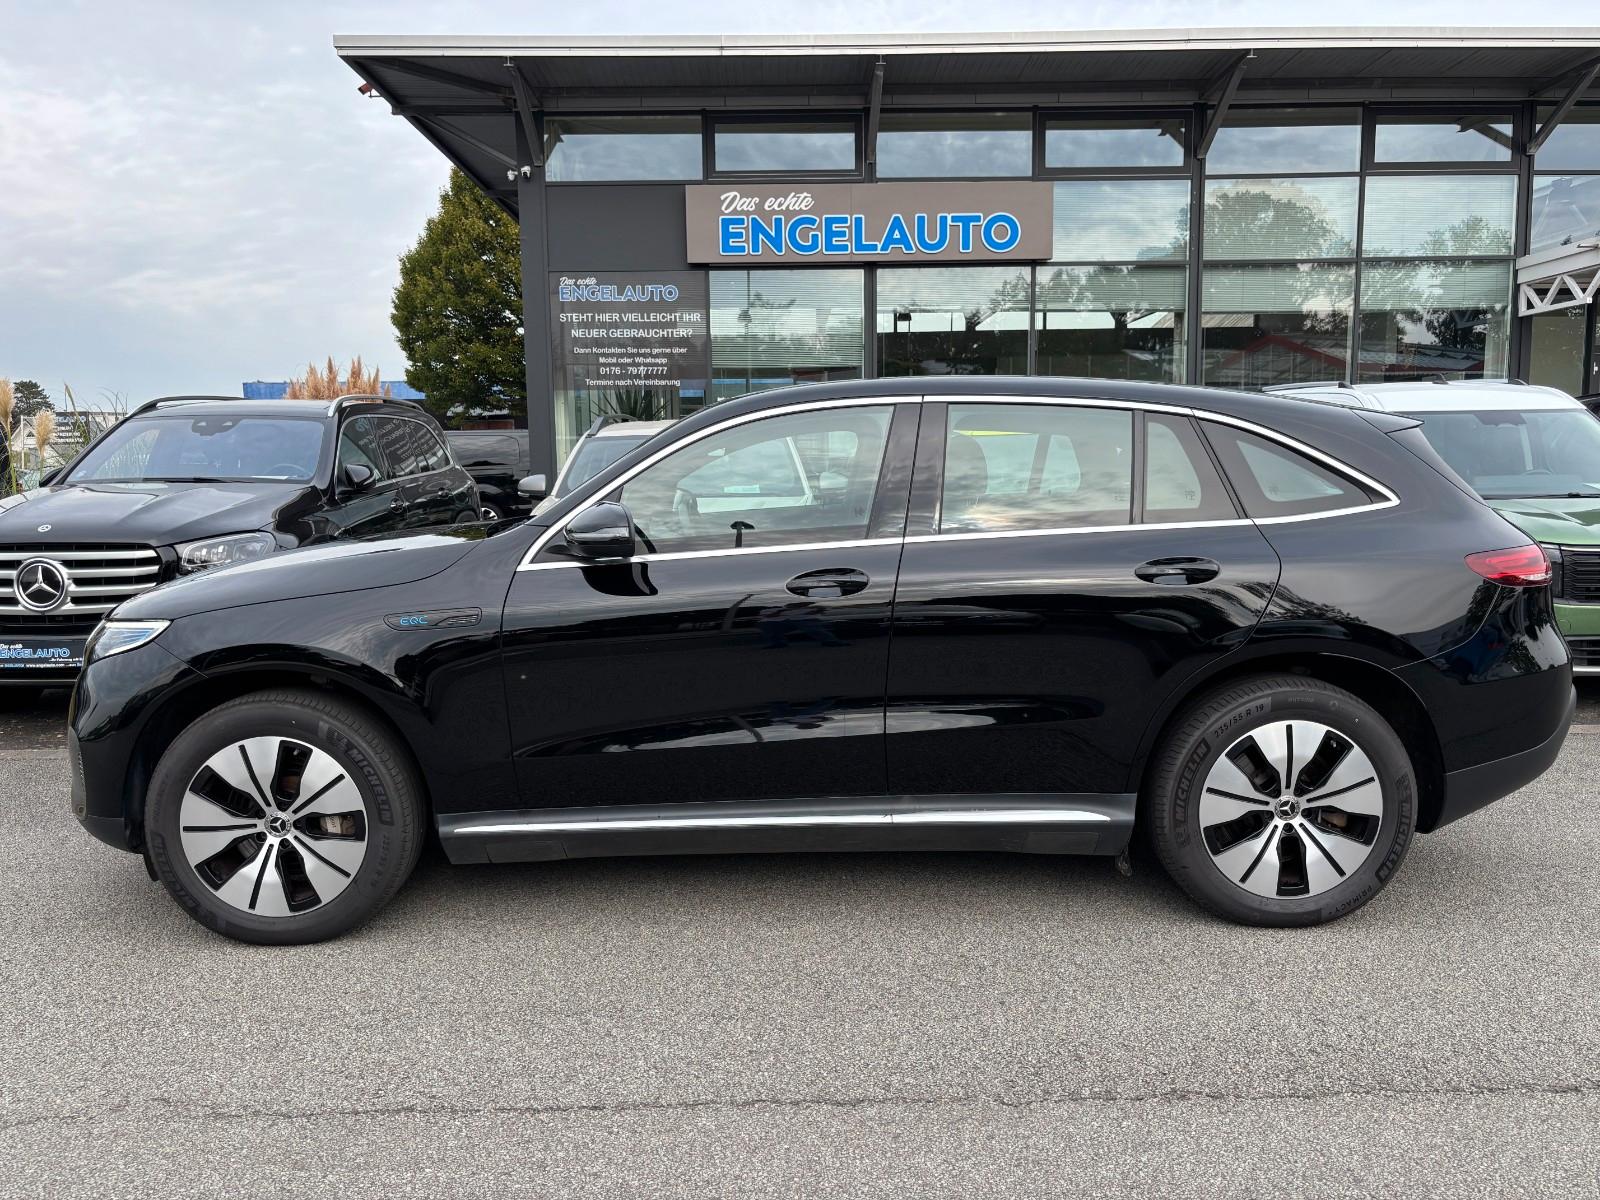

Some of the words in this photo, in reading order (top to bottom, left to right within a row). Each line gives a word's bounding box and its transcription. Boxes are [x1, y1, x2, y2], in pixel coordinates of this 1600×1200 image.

[720, 191, 758, 212] Das
[764, 192, 815, 211] echte
[719, 212, 1022, 256] ENGELAUTO
[559, 277, 576, 286] Das
[559, 285, 679, 302] ENGELAUTO
[559, 313, 593, 323] STEHT
[595, 313, 620, 323] HIER
[621, 312, 681, 322] VIELLEICHT
[682, 312, 701, 322] IHR
[571, 329, 608, 338] NEUER
[609, 328, 693, 338] GEBRAUCHTER?
[652, 348, 671, 356] gerne
[672, 346, 688, 354] über
[599, 356, 617, 364] Mobil
[618, 356, 633, 364] oder
[634, 356, 668, 365] Whatsapp
[600, 367, 621, 375] 0176
[615, 378, 633, 386] nach
[634, 378, 681, 387] Vereinbarung
[400, 615, 429, 626] EQC
[0, 648, 70, 658] ENGELAUTO
[1255, 703, 1265, 713] 19
[1174, 742, 1210, 820] MICHELIN
[350, 747, 392, 826] MICHELIN
[1378, 802, 1410, 881] MICHELIN
